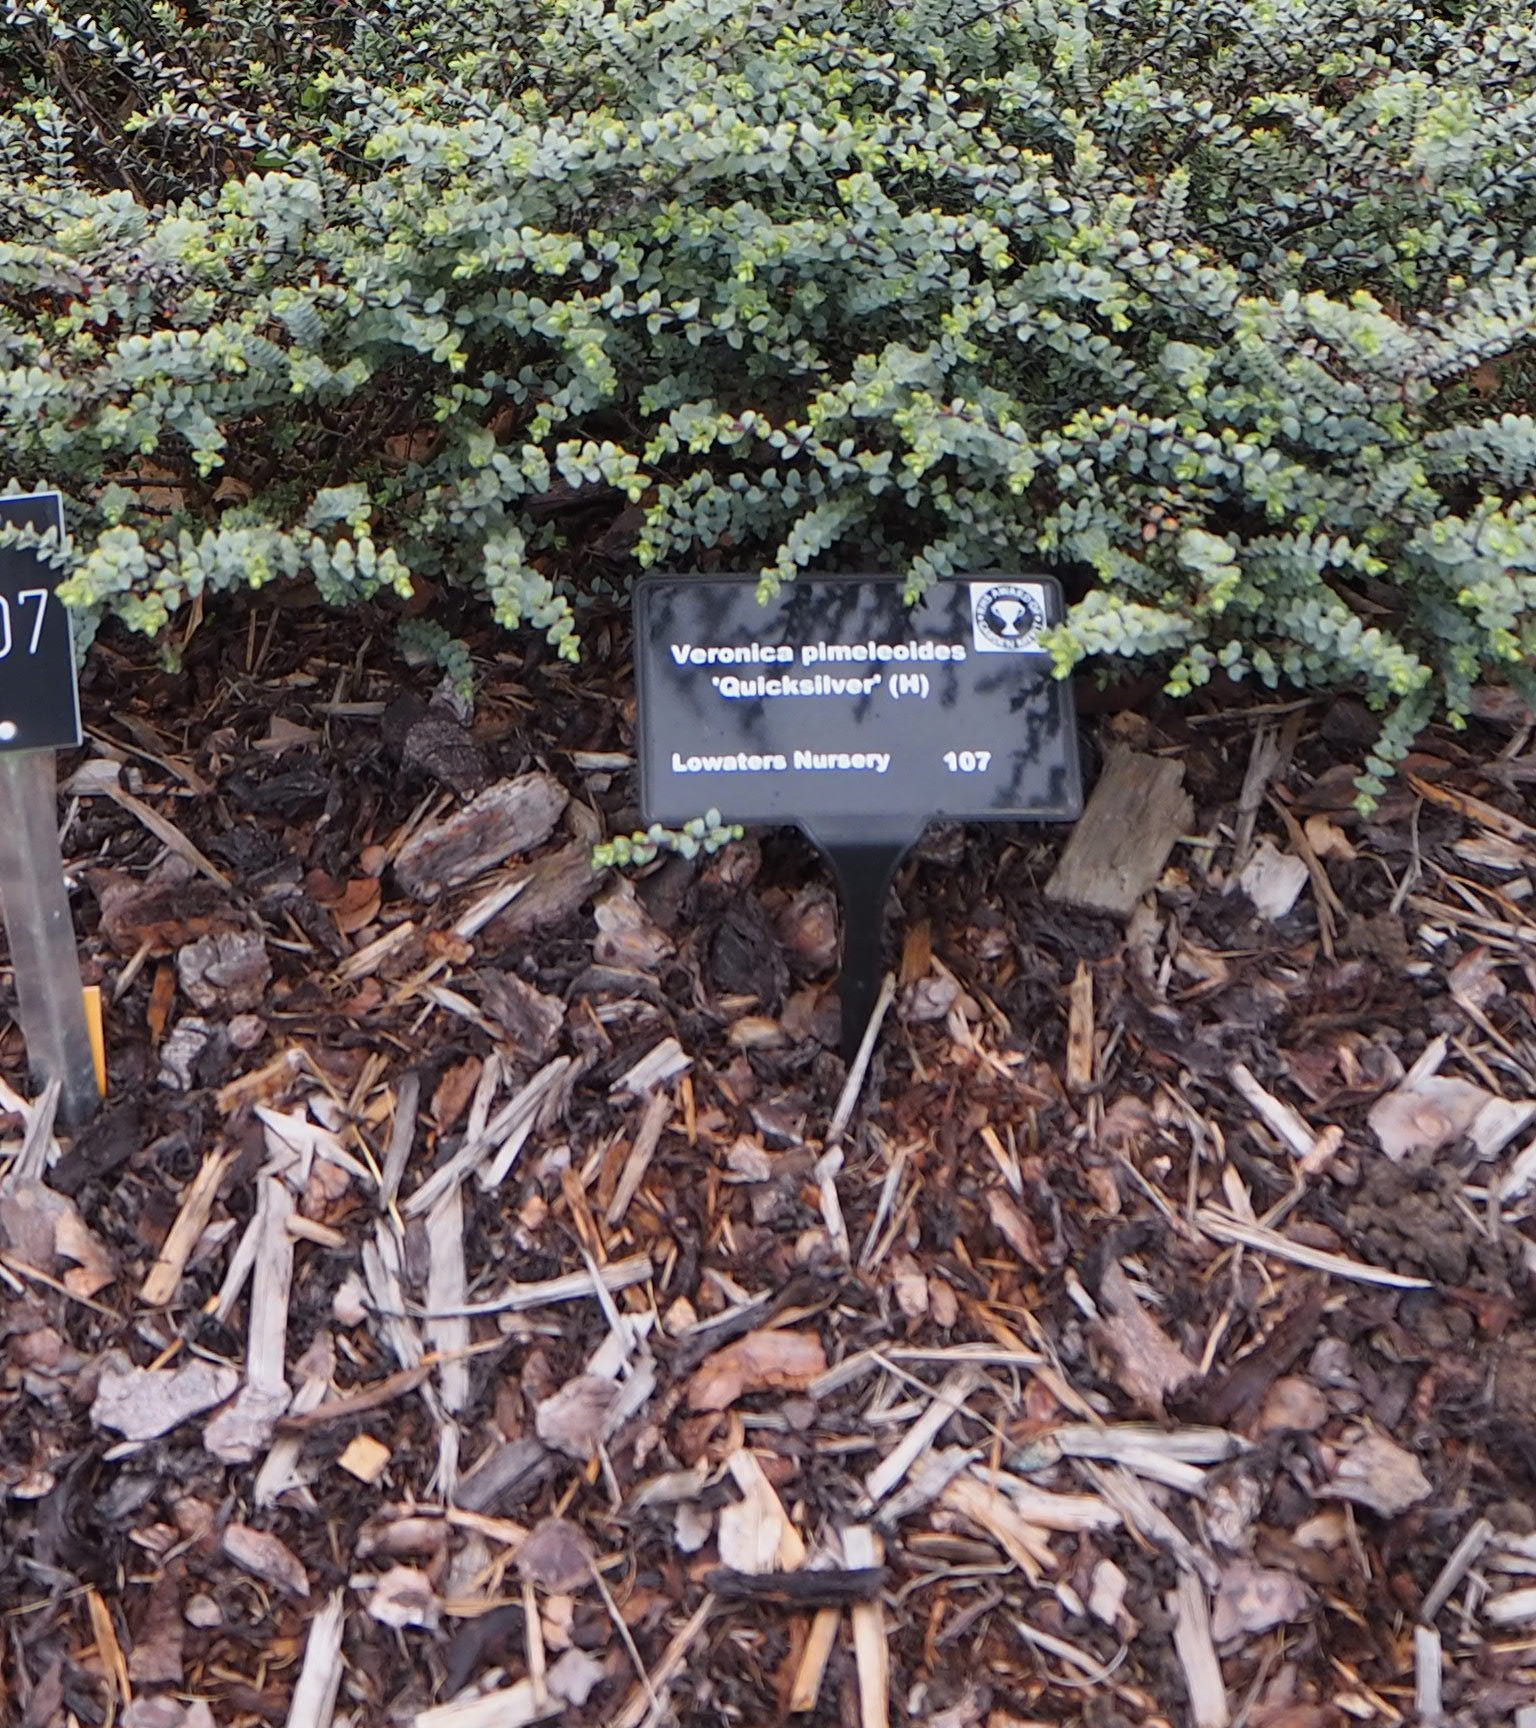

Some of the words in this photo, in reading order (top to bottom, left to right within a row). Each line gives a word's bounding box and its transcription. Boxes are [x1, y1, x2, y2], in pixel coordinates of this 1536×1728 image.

[670, 642, 794, 664] Veronica
[801, 640, 967, 666] pimeleoides
[712, 673, 882, 697] 'Quicksilver'
[888, 673, 930, 699] (H)
[672, 752, 787, 772] Lowaters
[793, 750, 891, 773] Nursery
[942, 750, 992, 772] 107
